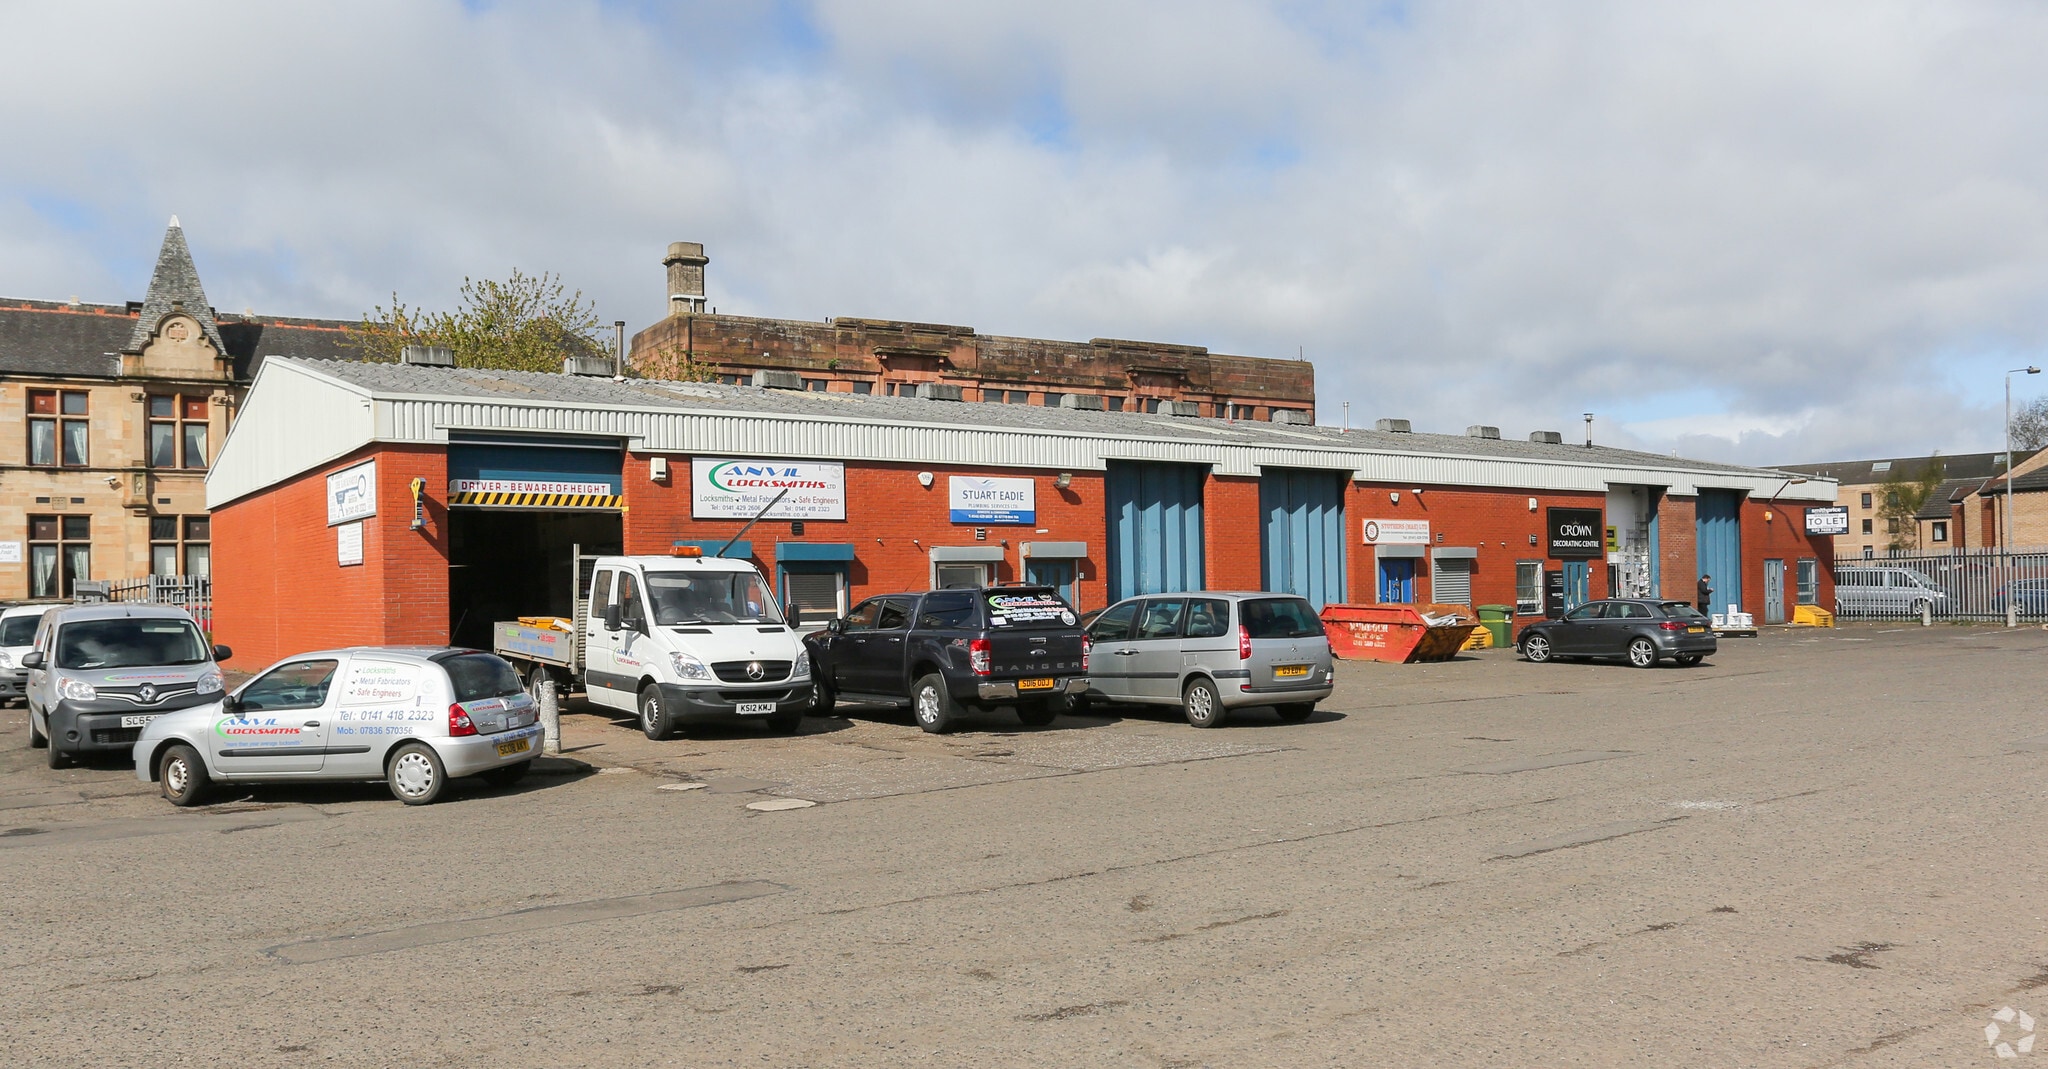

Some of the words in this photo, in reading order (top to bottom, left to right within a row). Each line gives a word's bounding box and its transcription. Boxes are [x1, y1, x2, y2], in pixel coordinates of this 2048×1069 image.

[724, 466, 801, 477] ANVIL
[462, 482, 502, 490] DRIVER
[511, 483, 553, 492] BEWARE
[556, 484, 568, 492] OF
[571, 484, 606, 494] HEIGHT
[727, 479, 826, 488] LOCKSMITHS
[700, 494, 734, 502] Locksmiths
[742, 495, 758, 503] Metal
[799, 496, 812, 504] Safe
[813, 496, 839, 505] Engineers
[963, 490, 997, 500] STUART
[1000, 491, 1024, 501] EADIE
[1827, 517, 1845, 525] LET
[1560, 525, 1592, 536] CROWN
[995, 662, 1079, 672] RANGER
[357, 688, 371, 696] Safe
[372, 688, 402, 698] Engineers
[741, 704, 757, 712] KS12
[339, 711, 356, 720] Tel:
[360, 711, 382, 720] 0141
[387, 711, 403, 720] 418
[408, 710, 434, 720] 2323
[126, 716, 152, 726] SC65
[360, 726, 383, 734] 07836
[386, 726, 413, 734] 570356
[500, 743, 516, 754] SC08
